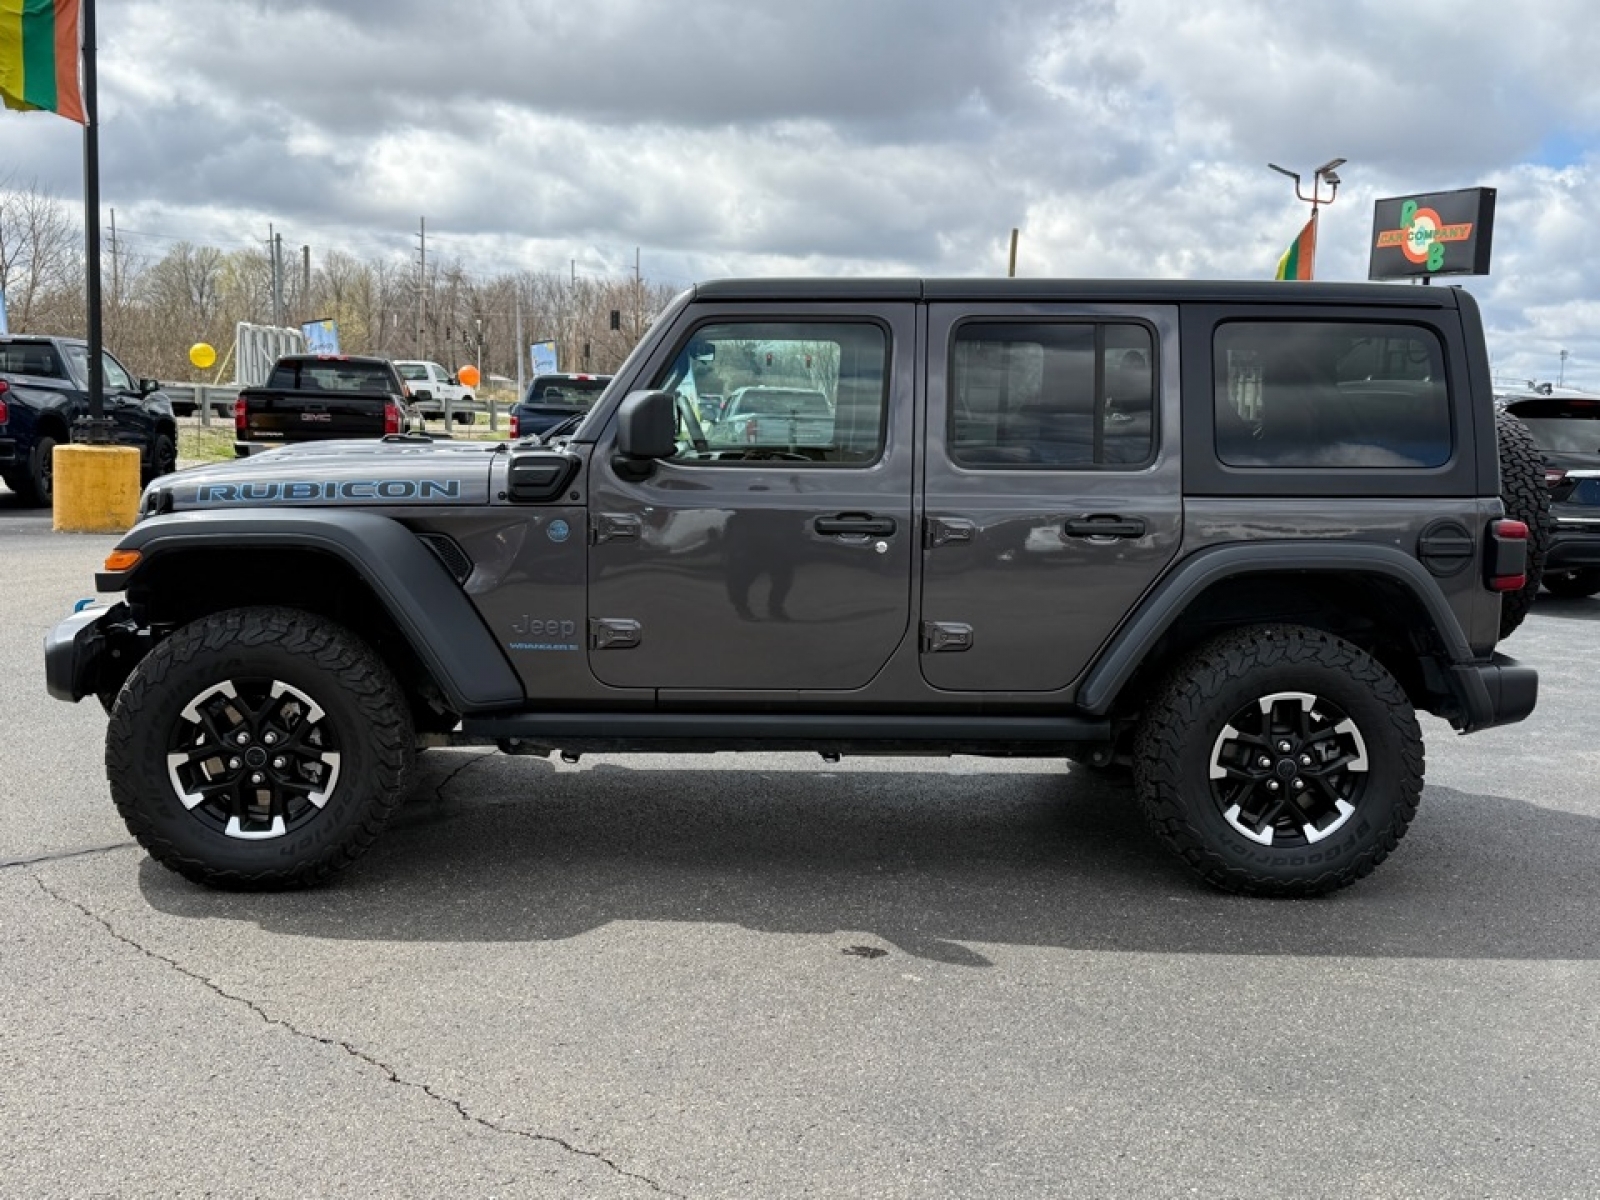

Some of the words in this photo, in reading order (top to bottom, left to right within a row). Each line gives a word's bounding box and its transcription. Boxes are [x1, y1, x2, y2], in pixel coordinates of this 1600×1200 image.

[1407, 226, 1468, 241] COMPANY
[1427, 242, 1445, 272] B
[197, 480, 461, 502] RUBICON
[512, 614, 575, 639] Jeep
